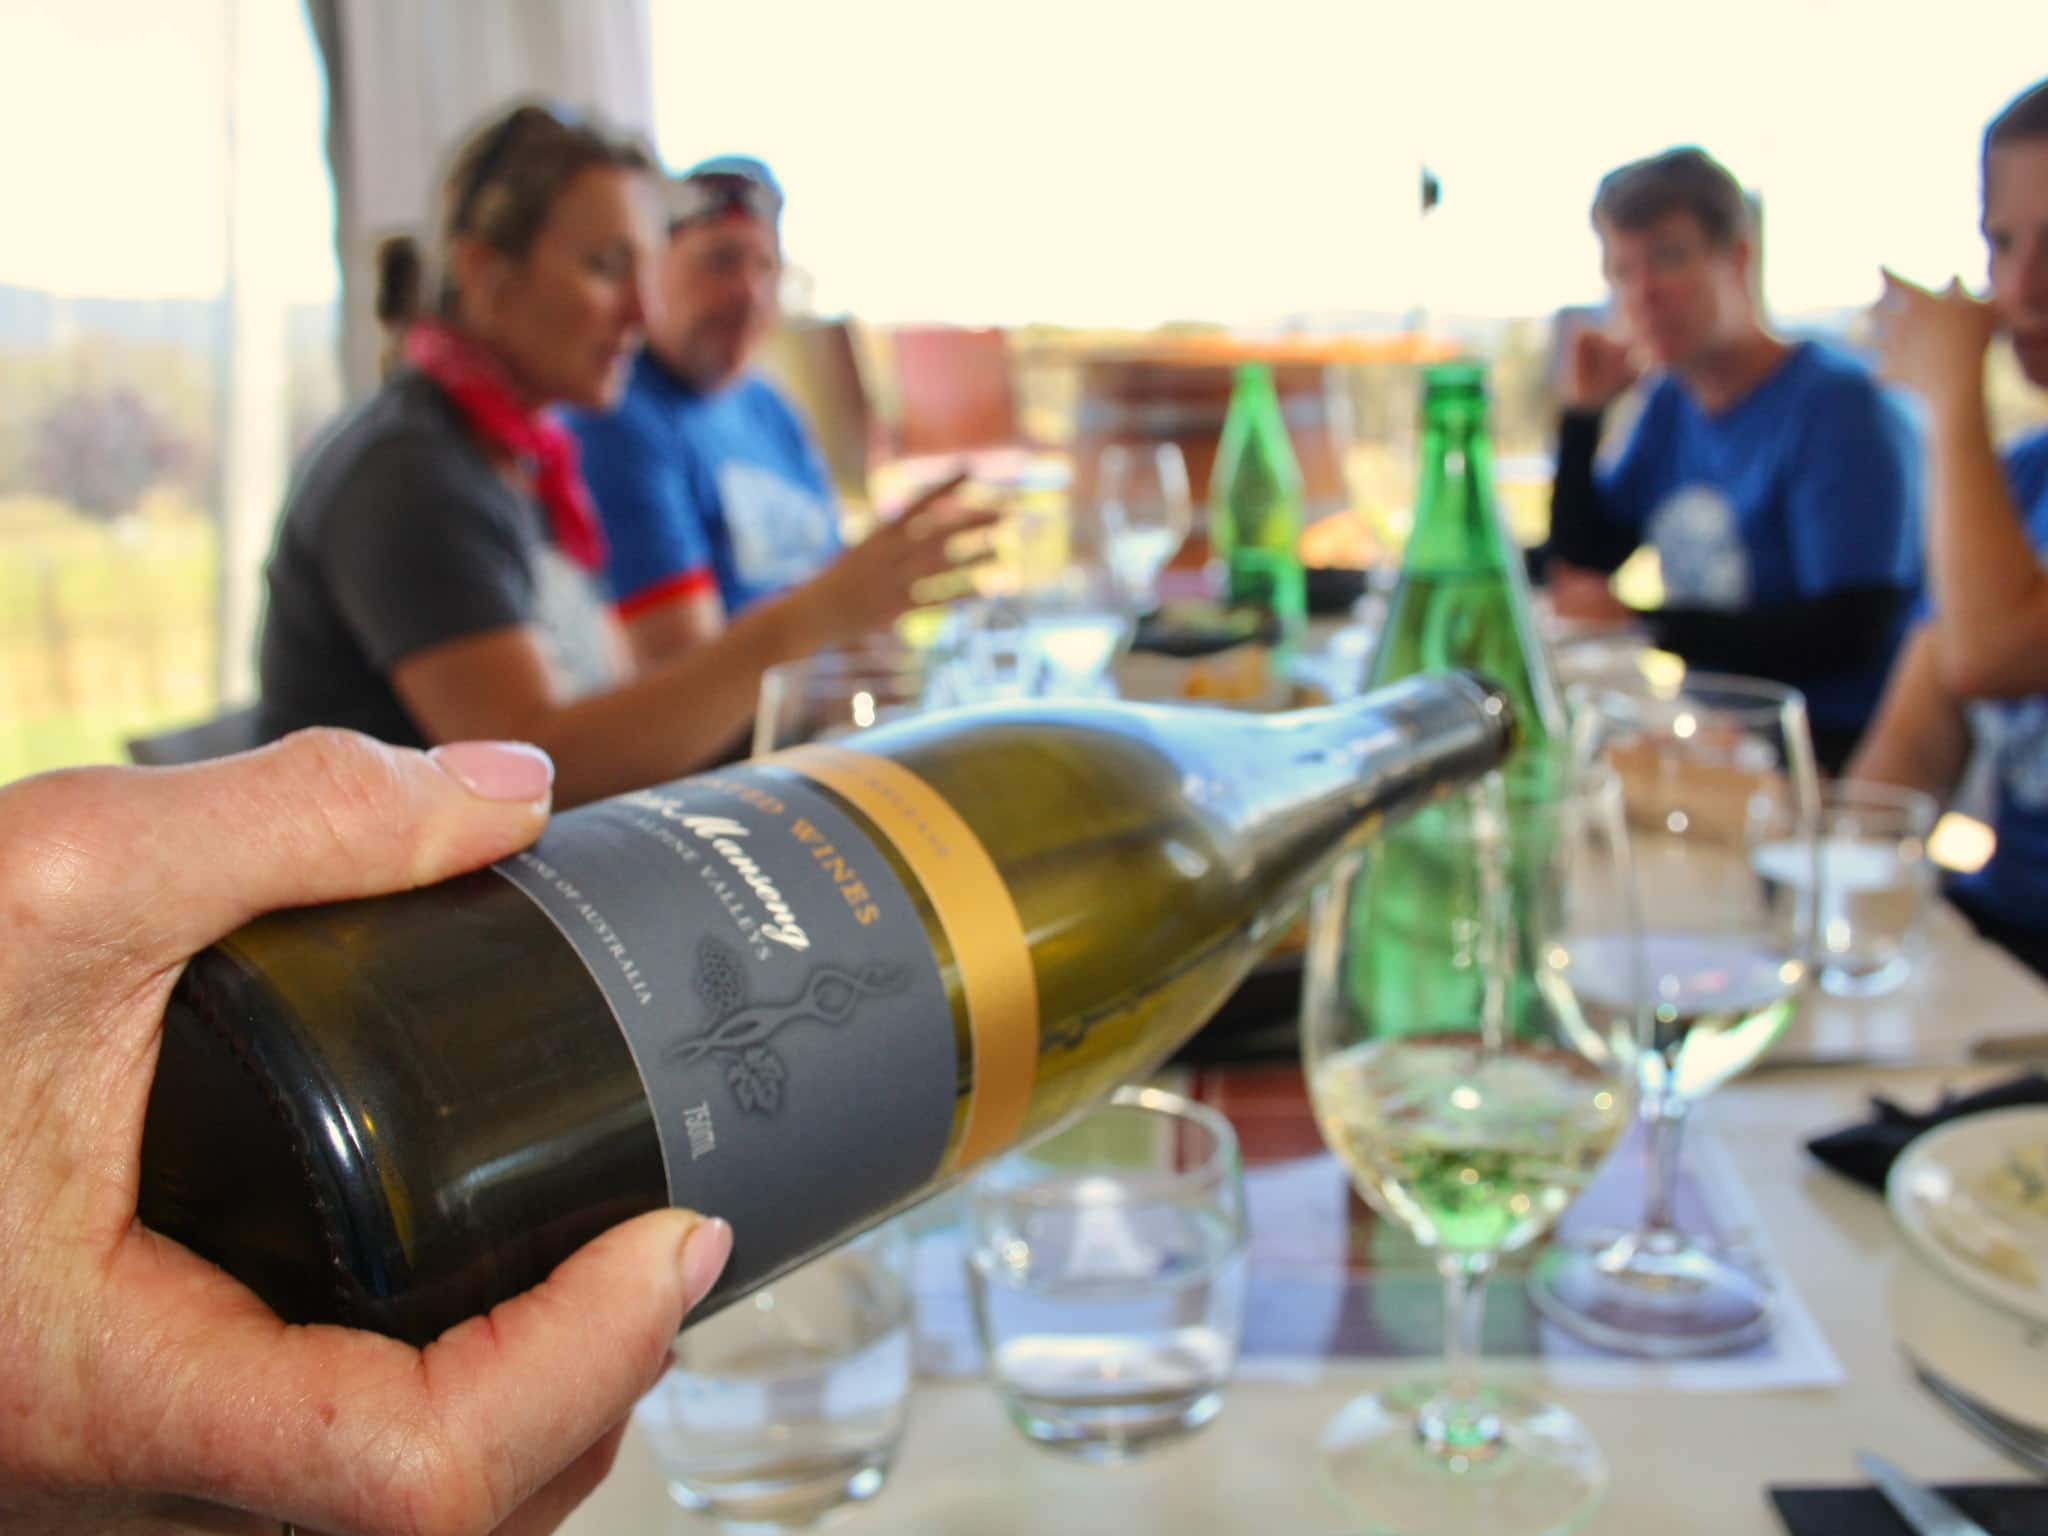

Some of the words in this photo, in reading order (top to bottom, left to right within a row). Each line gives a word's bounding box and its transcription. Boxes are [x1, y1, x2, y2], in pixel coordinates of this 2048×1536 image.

[699, 864, 770, 961] VALLEYS
[790, 817, 879, 926] WINES
[554, 879, 580, 899] OF
[576, 903, 653, 1007] AUSTRALIA
